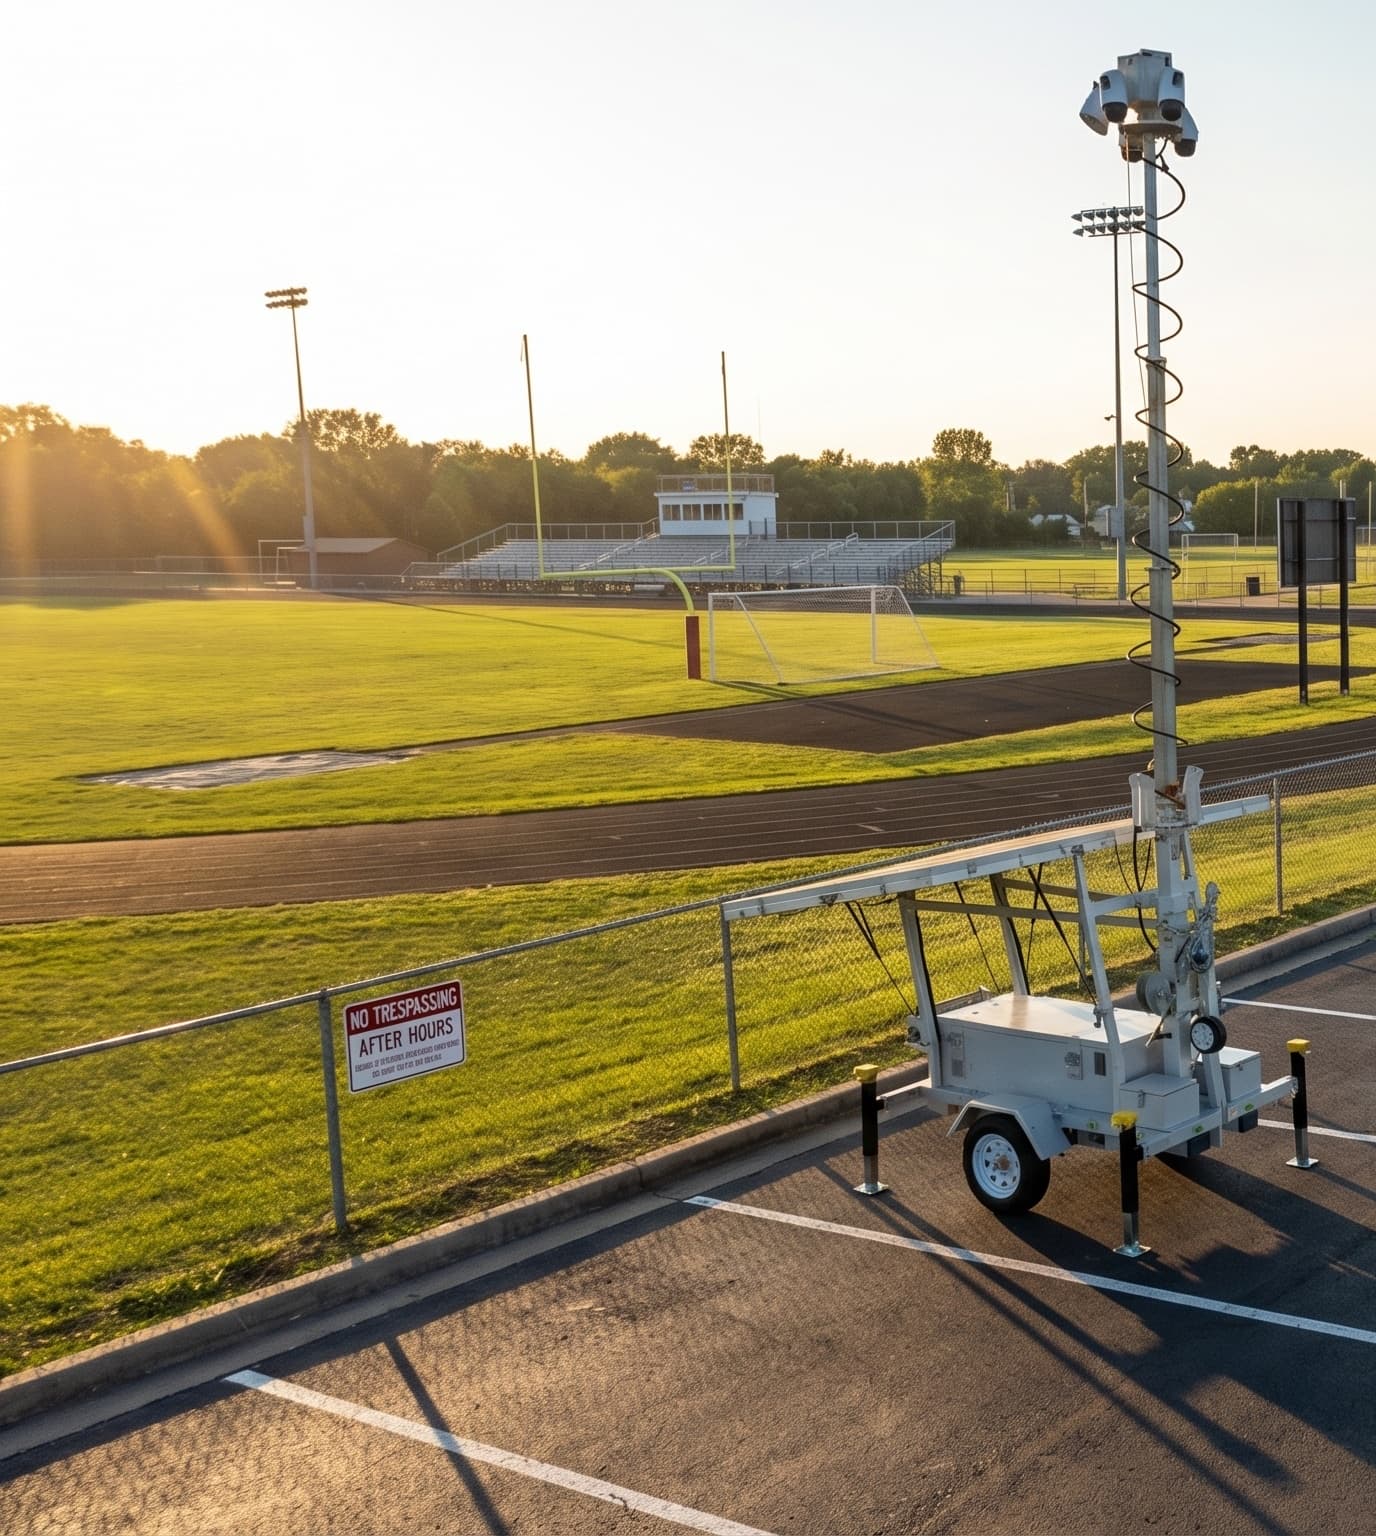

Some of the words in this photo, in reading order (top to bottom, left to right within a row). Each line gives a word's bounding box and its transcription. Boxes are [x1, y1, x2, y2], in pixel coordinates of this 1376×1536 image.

[350, 1008, 369, 1030] NO
[372, 987, 457, 1025] TRESPASSING
[360, 1030, 402, 1058] AFTER
[408, 1017, 454, 1044] HOURS
